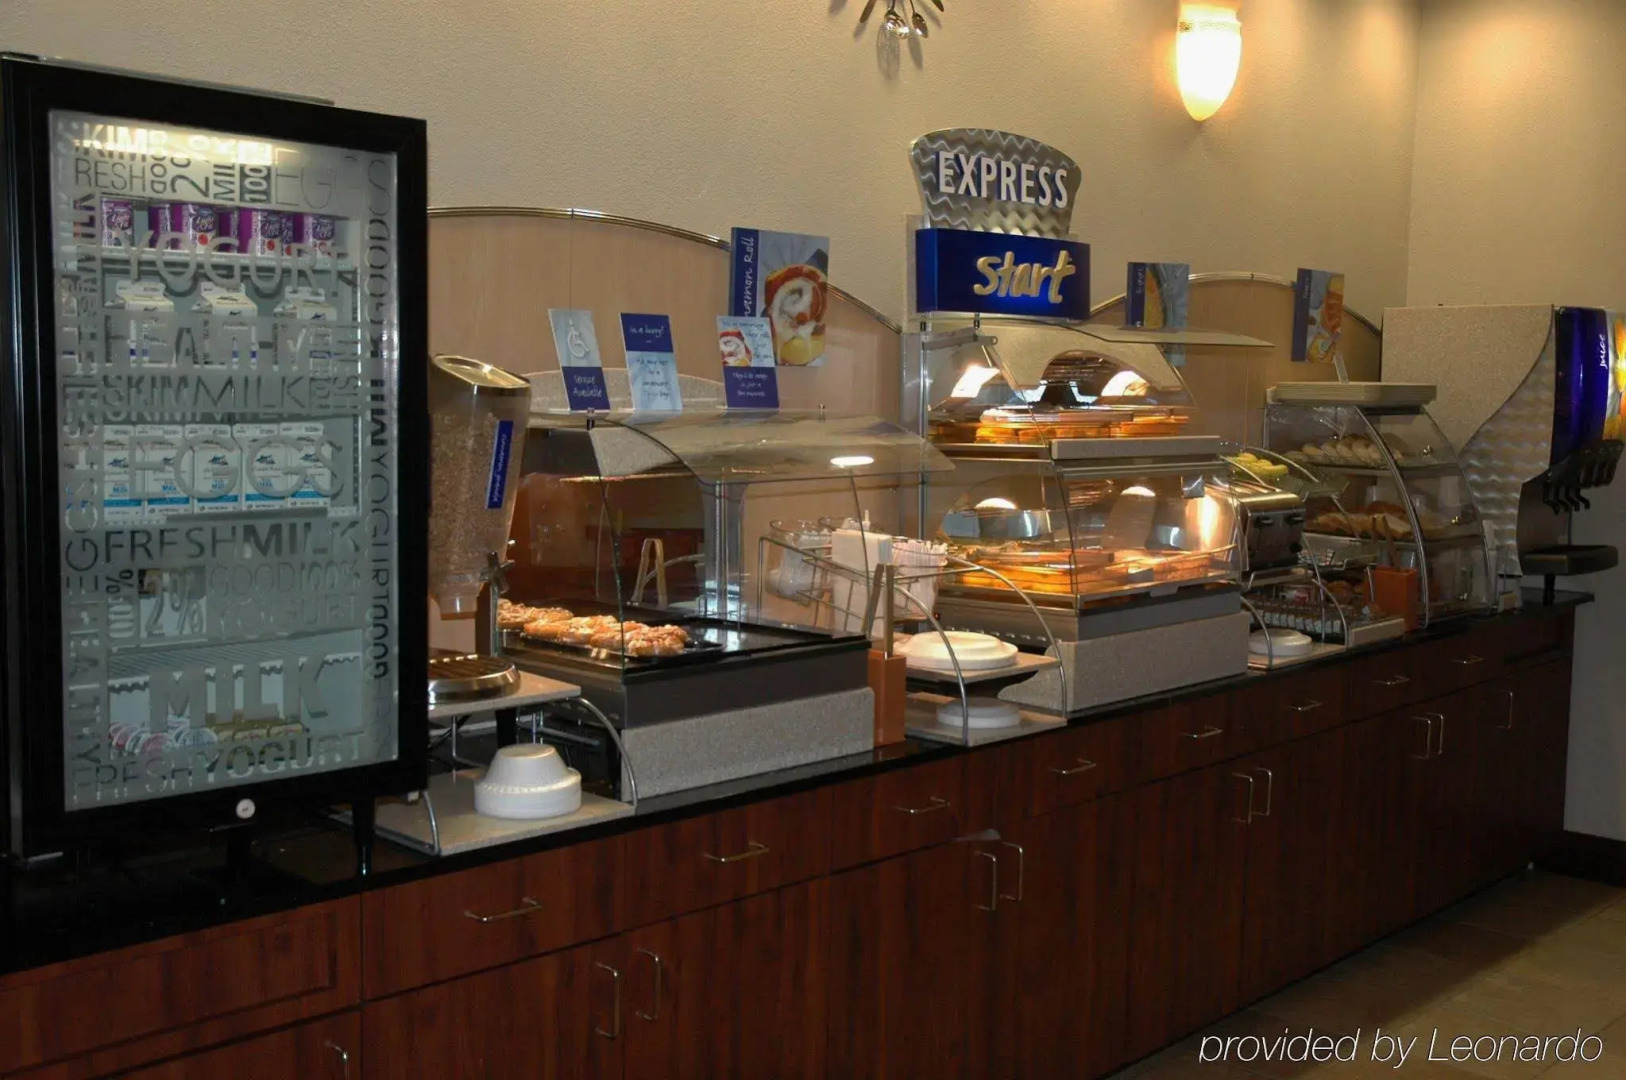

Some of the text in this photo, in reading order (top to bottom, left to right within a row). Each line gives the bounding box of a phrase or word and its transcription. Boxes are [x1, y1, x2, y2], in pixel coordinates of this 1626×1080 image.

[936, 150, 1069, 210] EXPRESS
[123, 229, 346, 292] YOGURT
[1599, 333, 1609, 371] juice
[127, 433, 346, 501] EGGS
[148, 658, 330, 734] MILK
